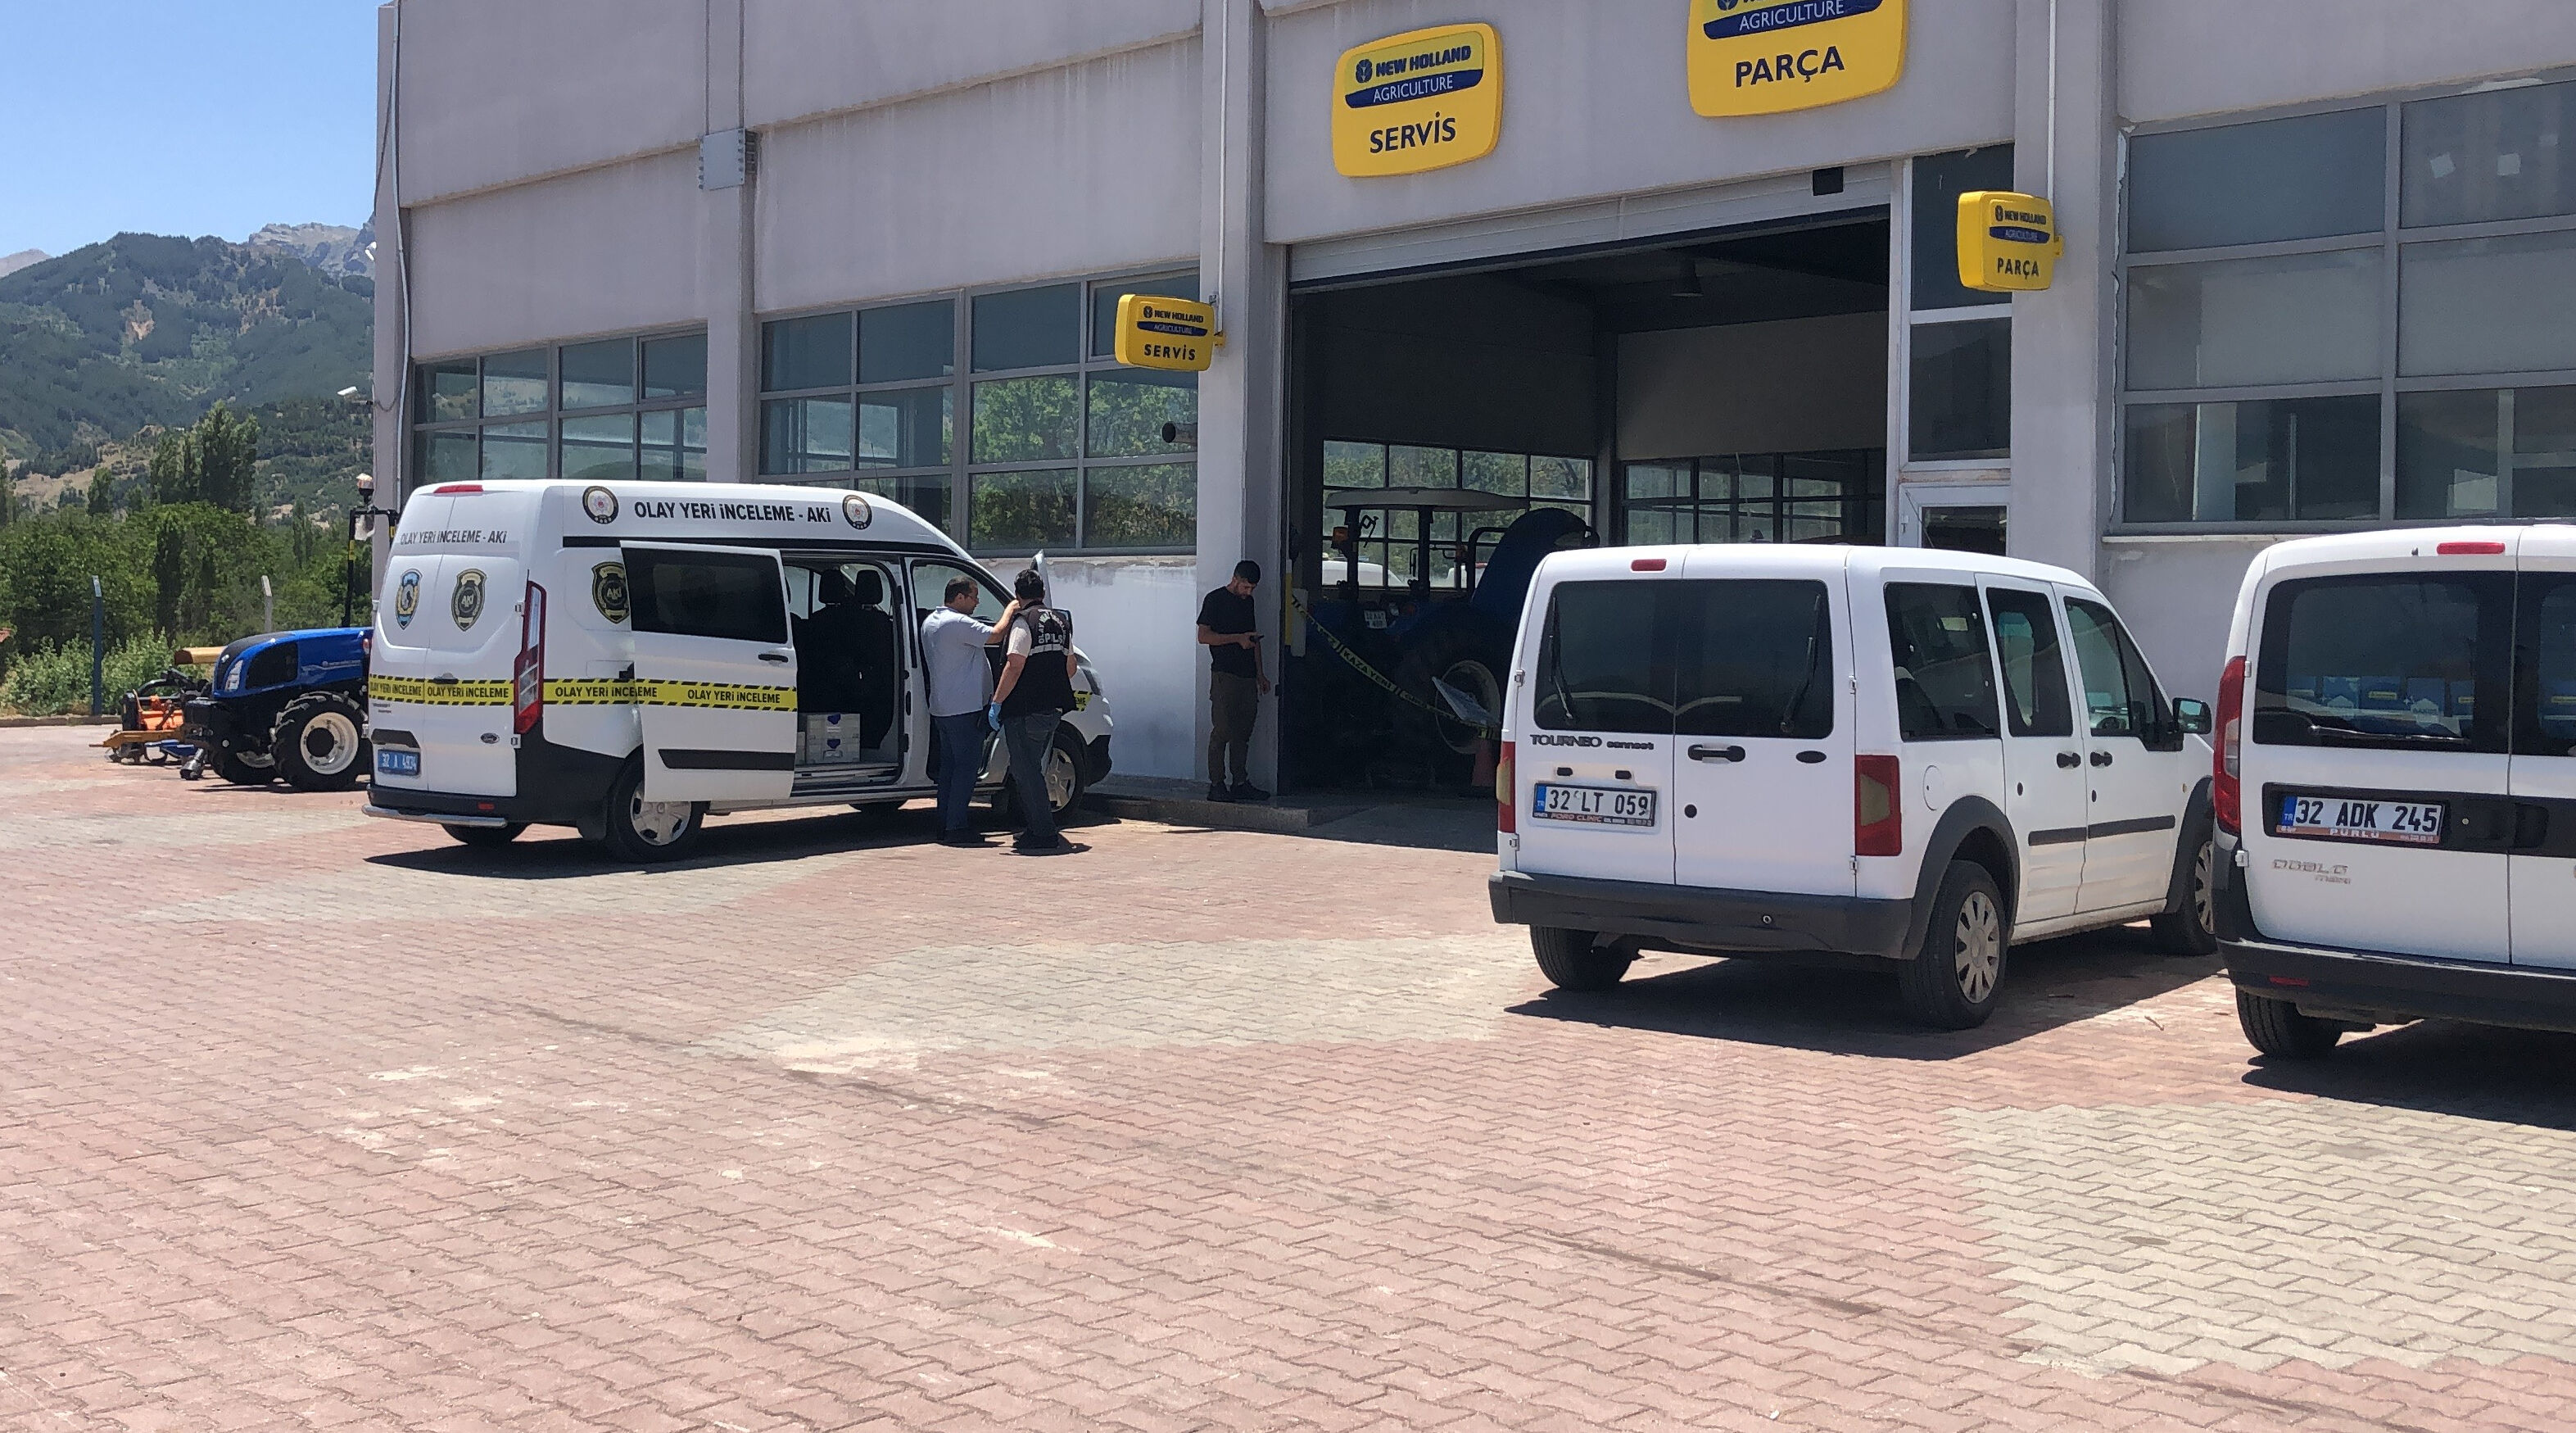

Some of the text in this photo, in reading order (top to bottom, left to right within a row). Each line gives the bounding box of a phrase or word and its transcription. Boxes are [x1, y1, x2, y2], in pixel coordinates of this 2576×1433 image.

[1739, 1, 1845, 31] AGRICULTURE
[1376, 45, 1472, 77] NEW HOLLAND
[1736, 45, 1845, 88] PARÇA
[1373, 75, 1454, 102] AGRICULTURE
[1369, 111, 1456, 153] SERVİS
[2004, 210, 2047, 225] NEW HOLLAND
[1997, 257, 2040, 279] PARÇA
[1154, 310, 1204, 323] NEW HOLLAND
[1153, 324, 1193, 334] AGRICULTURE
[1143, 343, 1196, 361] SERVİS
[634, 501, 676, 519] OLAY
[400, 532, 419, 545] OLAY
[427, 686, 445, 697] OLAY
[555, 687, 582, 698] OLAY
[687, 689, 712, 701] OLAY
[1530, 734, 1603, 747] TOURNEO
[1549, 789, 1649, 816] 32 LT 059
[2284, 813, 2293, 821] TR
[2295, 799, 2438, 832] 32 ADK 245
